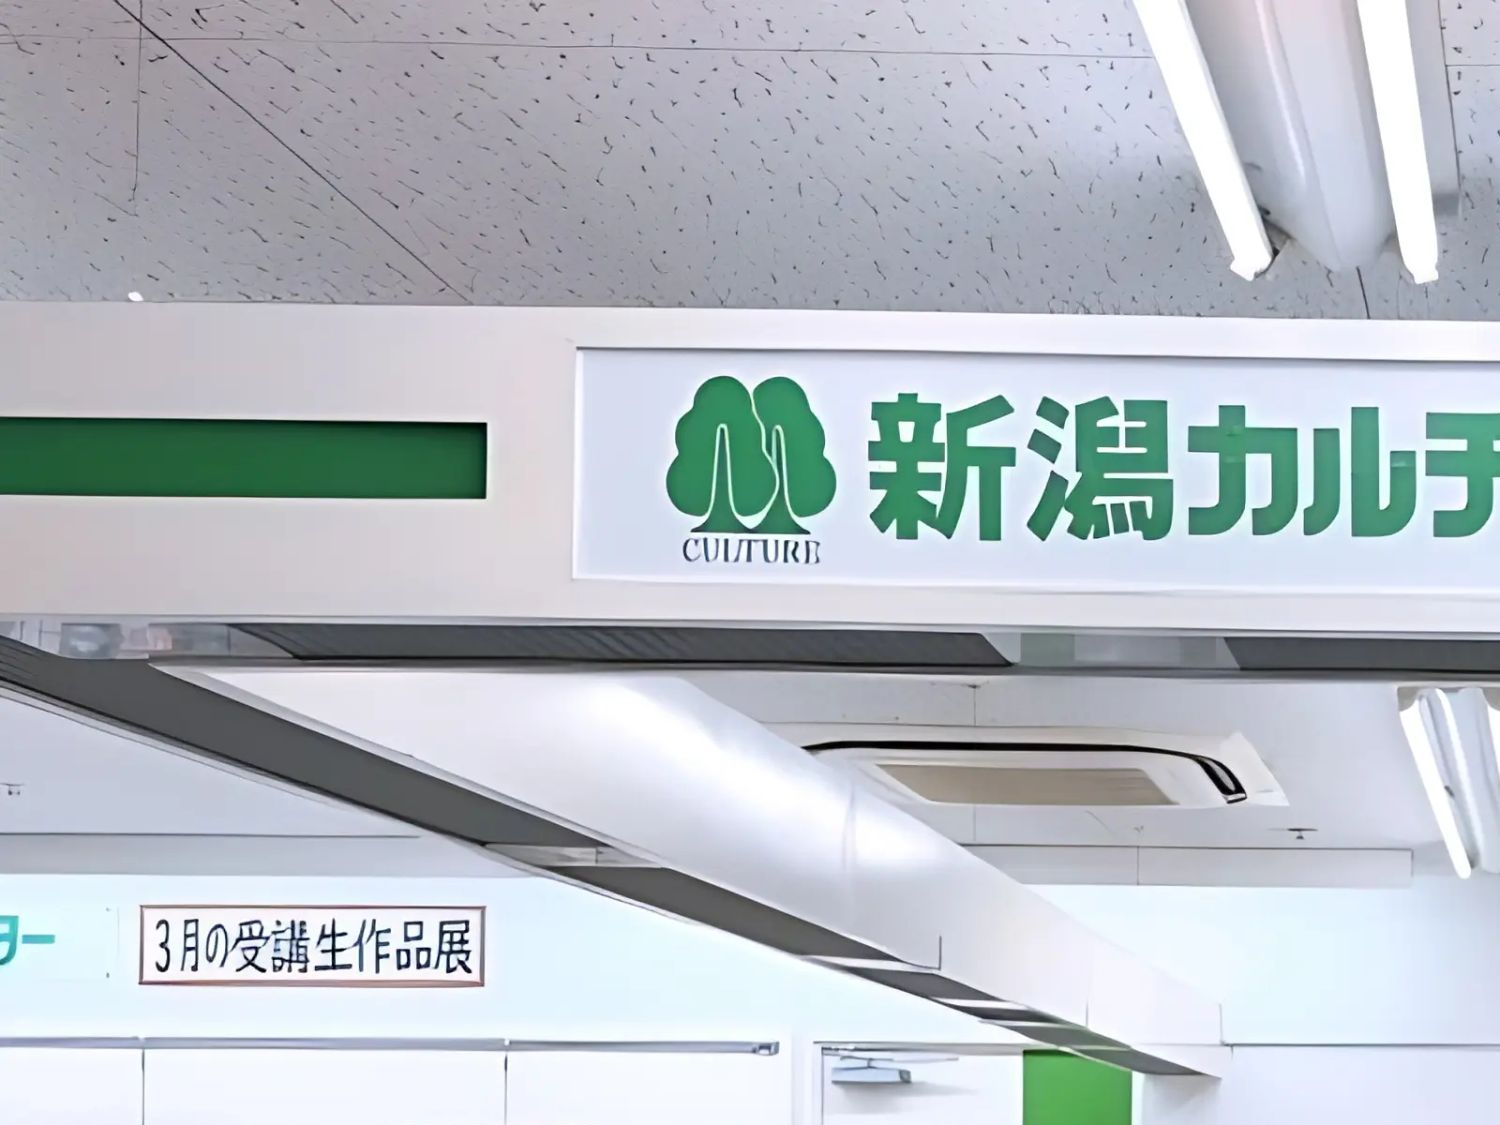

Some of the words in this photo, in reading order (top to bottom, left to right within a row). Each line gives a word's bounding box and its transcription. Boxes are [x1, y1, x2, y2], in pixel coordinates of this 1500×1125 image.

[682, 537, 821, 565] CULTURE
[154, 917, 474, 975] 3月の受講生作品展
